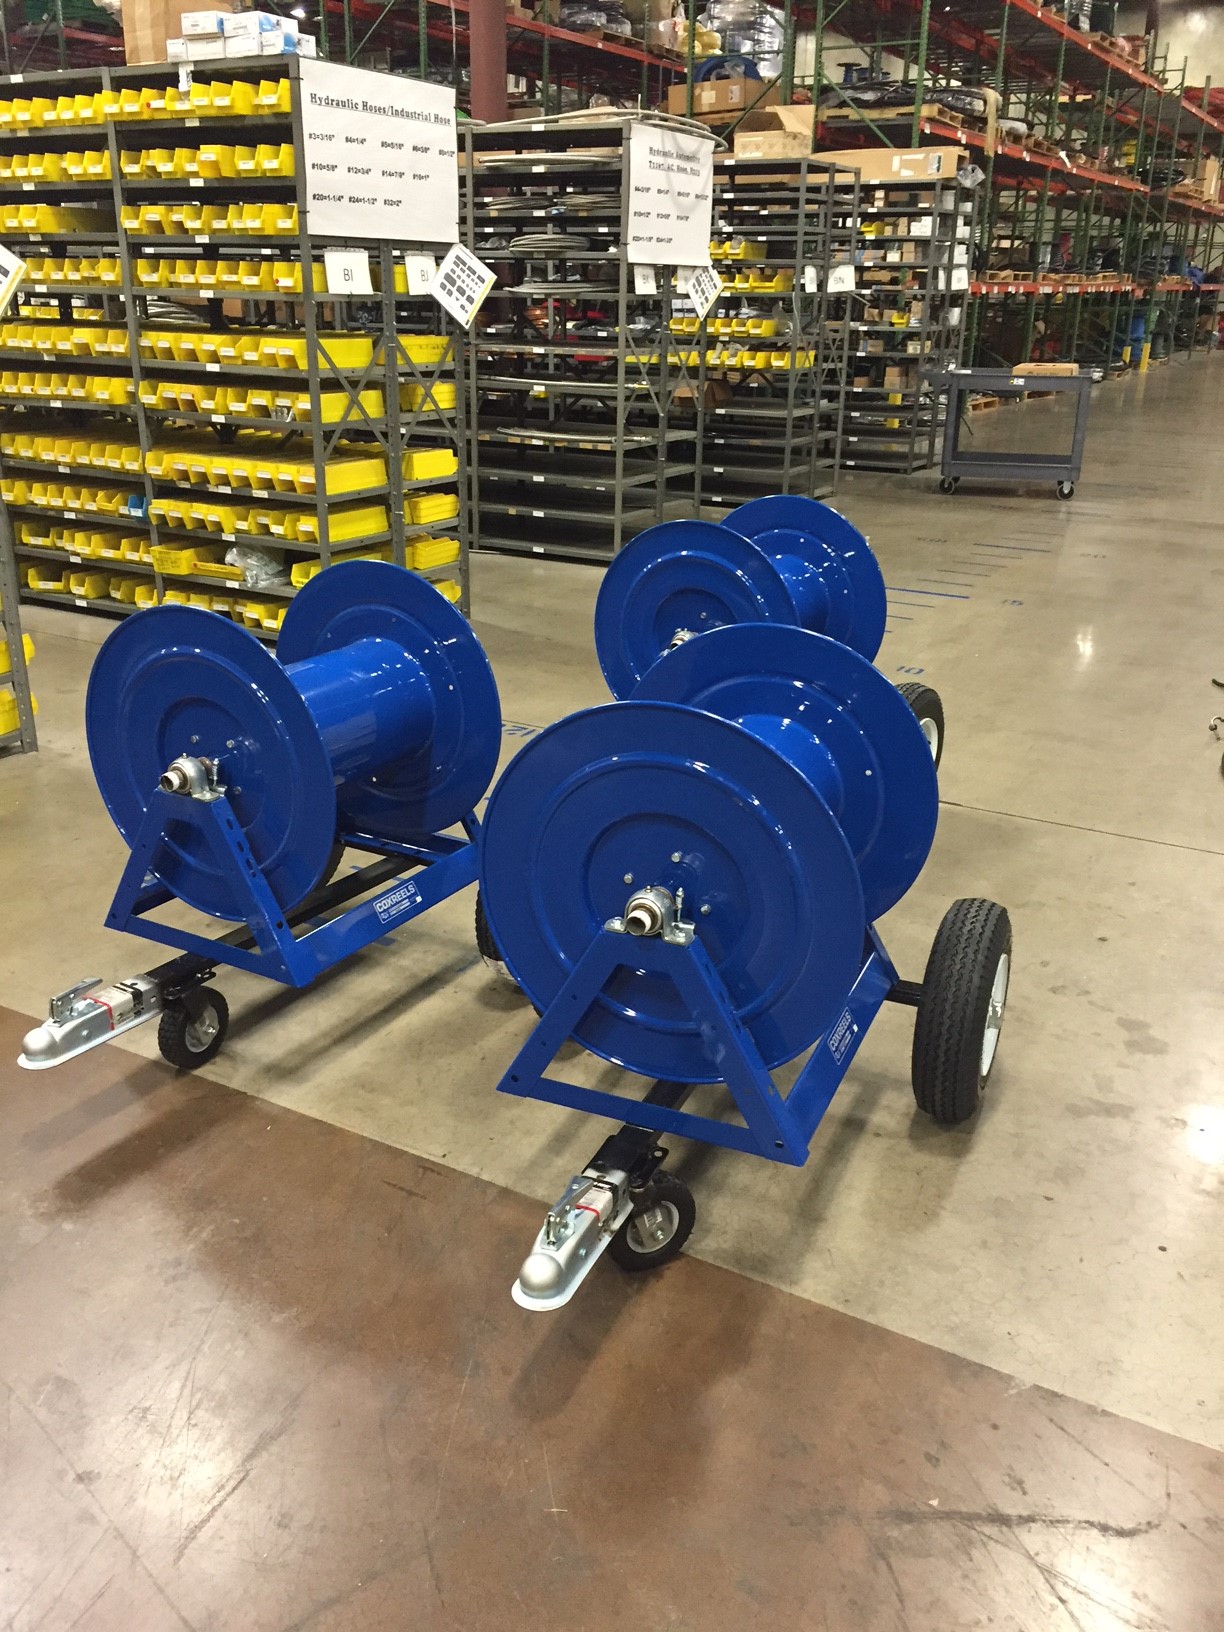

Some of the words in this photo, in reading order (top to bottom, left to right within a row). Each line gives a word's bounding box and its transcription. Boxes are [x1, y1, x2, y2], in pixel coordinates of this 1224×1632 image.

[310, 93, 359, 110] Hydraulic
[362, 101, 431, 122] Hoses/Industrial
[433, 113, 451, 125] Hose
[376, 884, 416, 912] COXREELS
[829, 1011, 852, 1051] COXREELS
